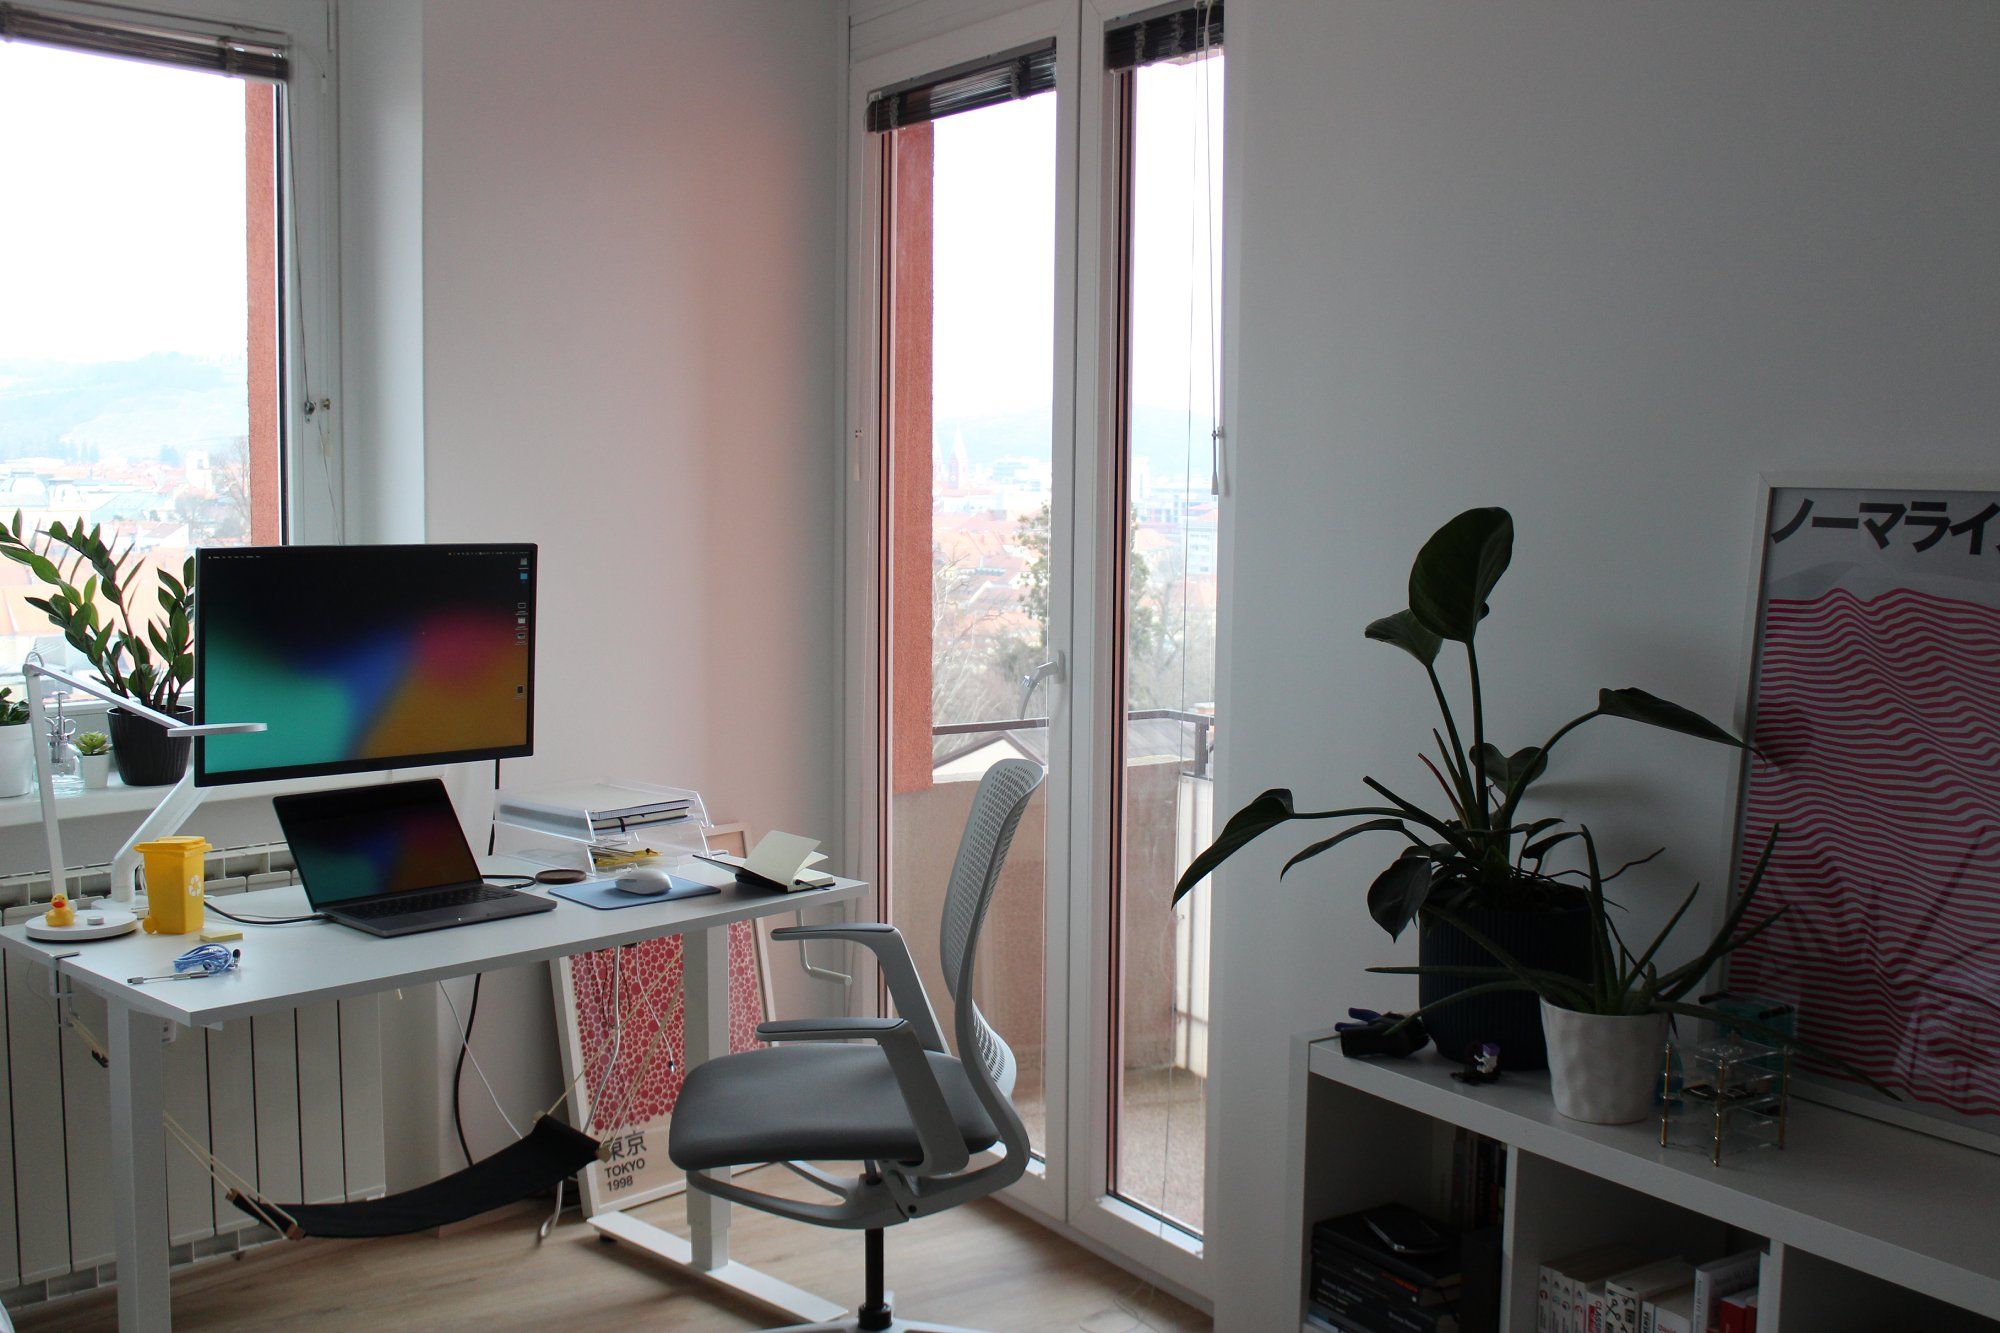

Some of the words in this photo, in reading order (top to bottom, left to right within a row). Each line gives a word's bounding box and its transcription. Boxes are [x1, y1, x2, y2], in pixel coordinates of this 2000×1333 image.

[1771, 498, 2000, 555] ノーマライ
[604, 1158, 645, 1178] TOKYO
[607, 1175, 632, 1192] 1998
